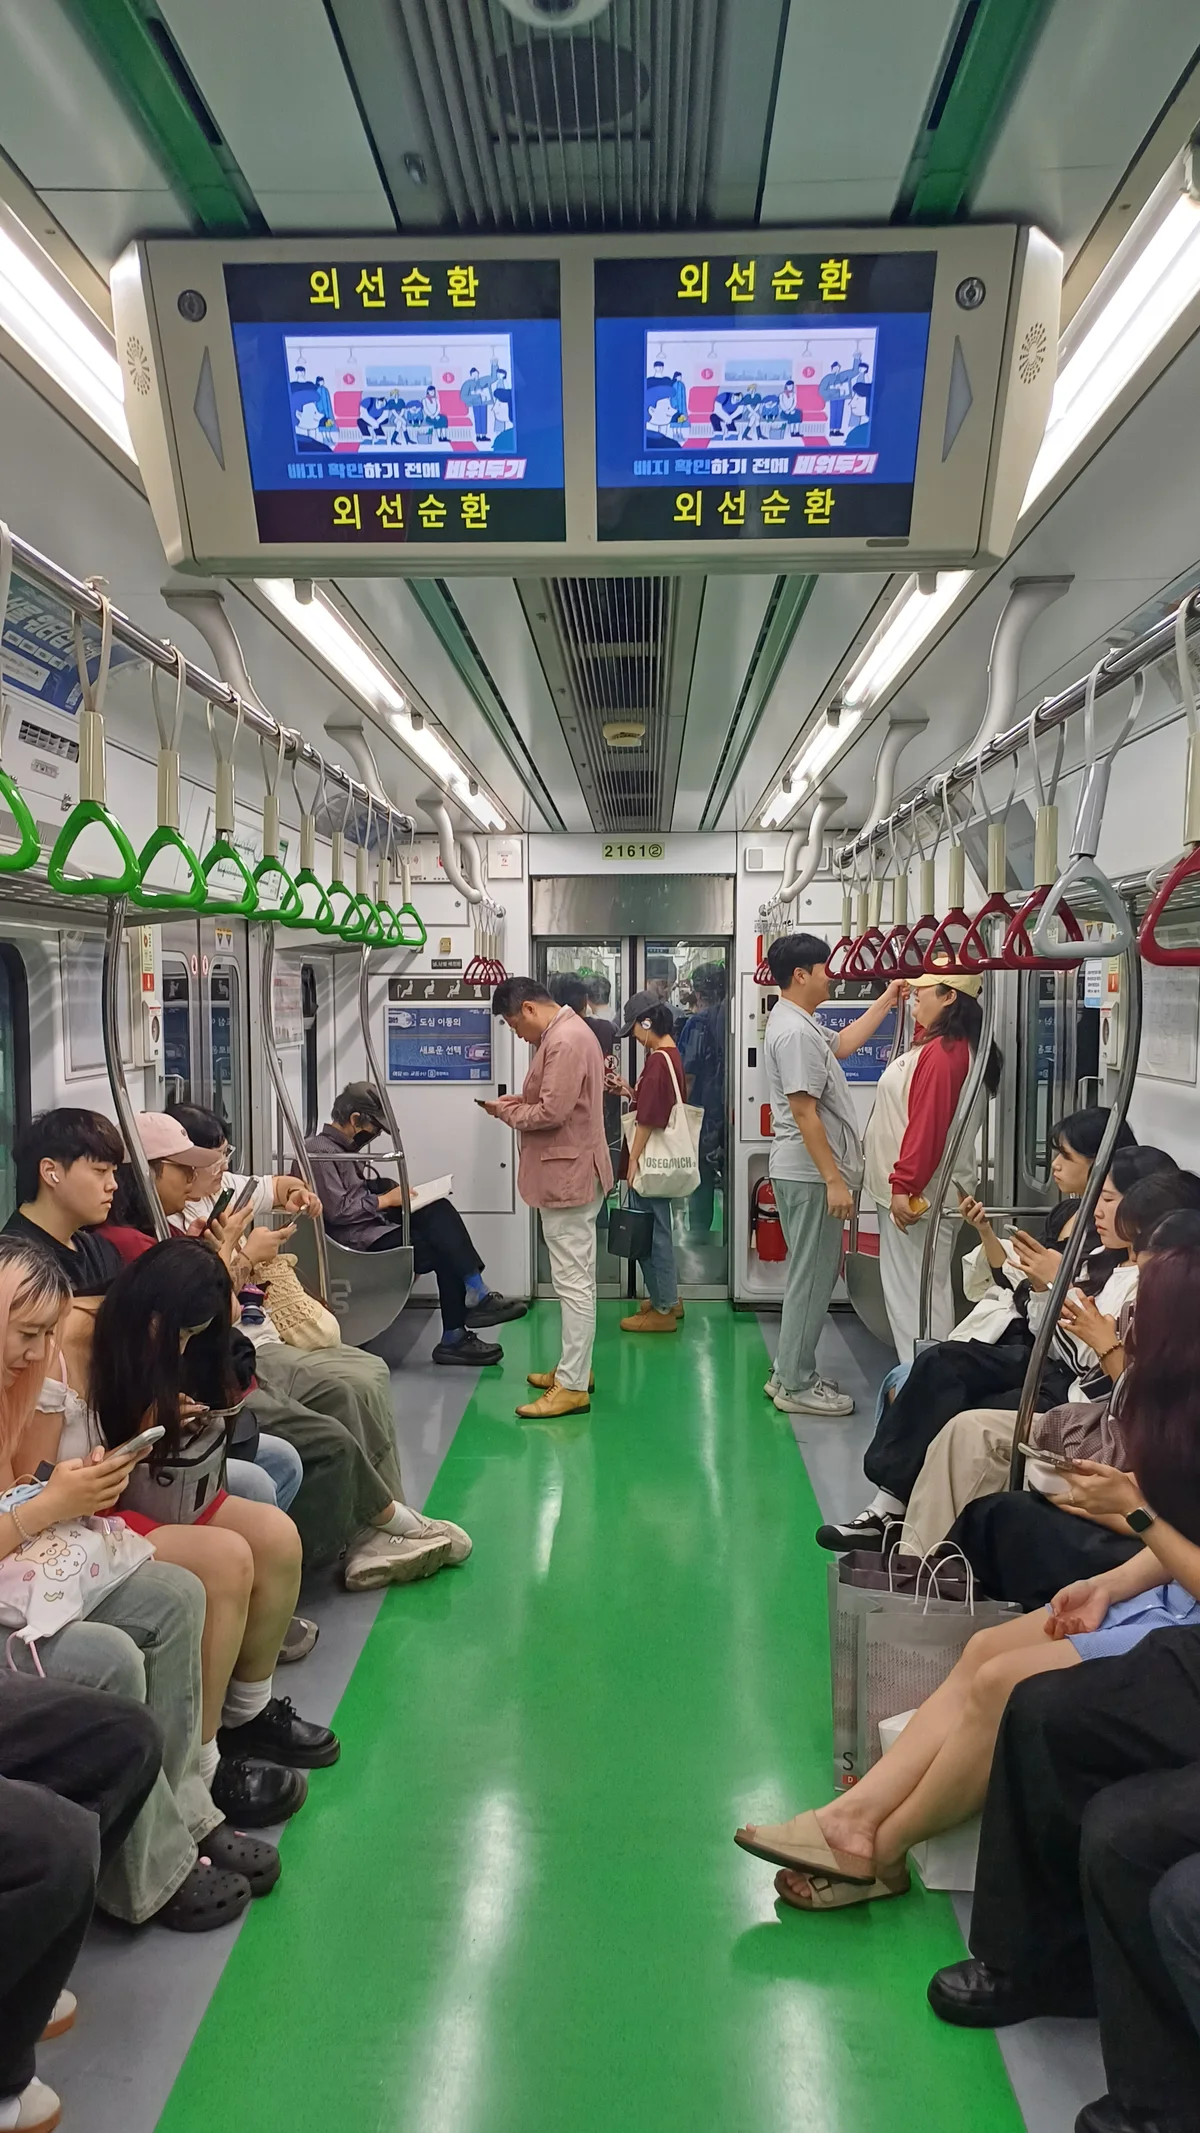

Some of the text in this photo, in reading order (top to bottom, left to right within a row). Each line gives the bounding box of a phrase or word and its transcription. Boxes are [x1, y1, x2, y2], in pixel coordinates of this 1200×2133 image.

[309, 265, 480, 309] 외선순환
[677, 258, 853, 303] 외선순환
[287, 462, 323, 479] 배지
[404, 462, 441, 479] 전에
[633, 458, 669, 476] 배지
[752, 457, 789, 475] 전에
[333, 492, 491, 530] 외선순환
[673, 487, 836, 526] 외선순환
[419, 1017, 461, 1027] 도심 이동의
[829, 1017, 846, 1028] 도심
[419, 1045, 462, 1055] 새로운 선택
